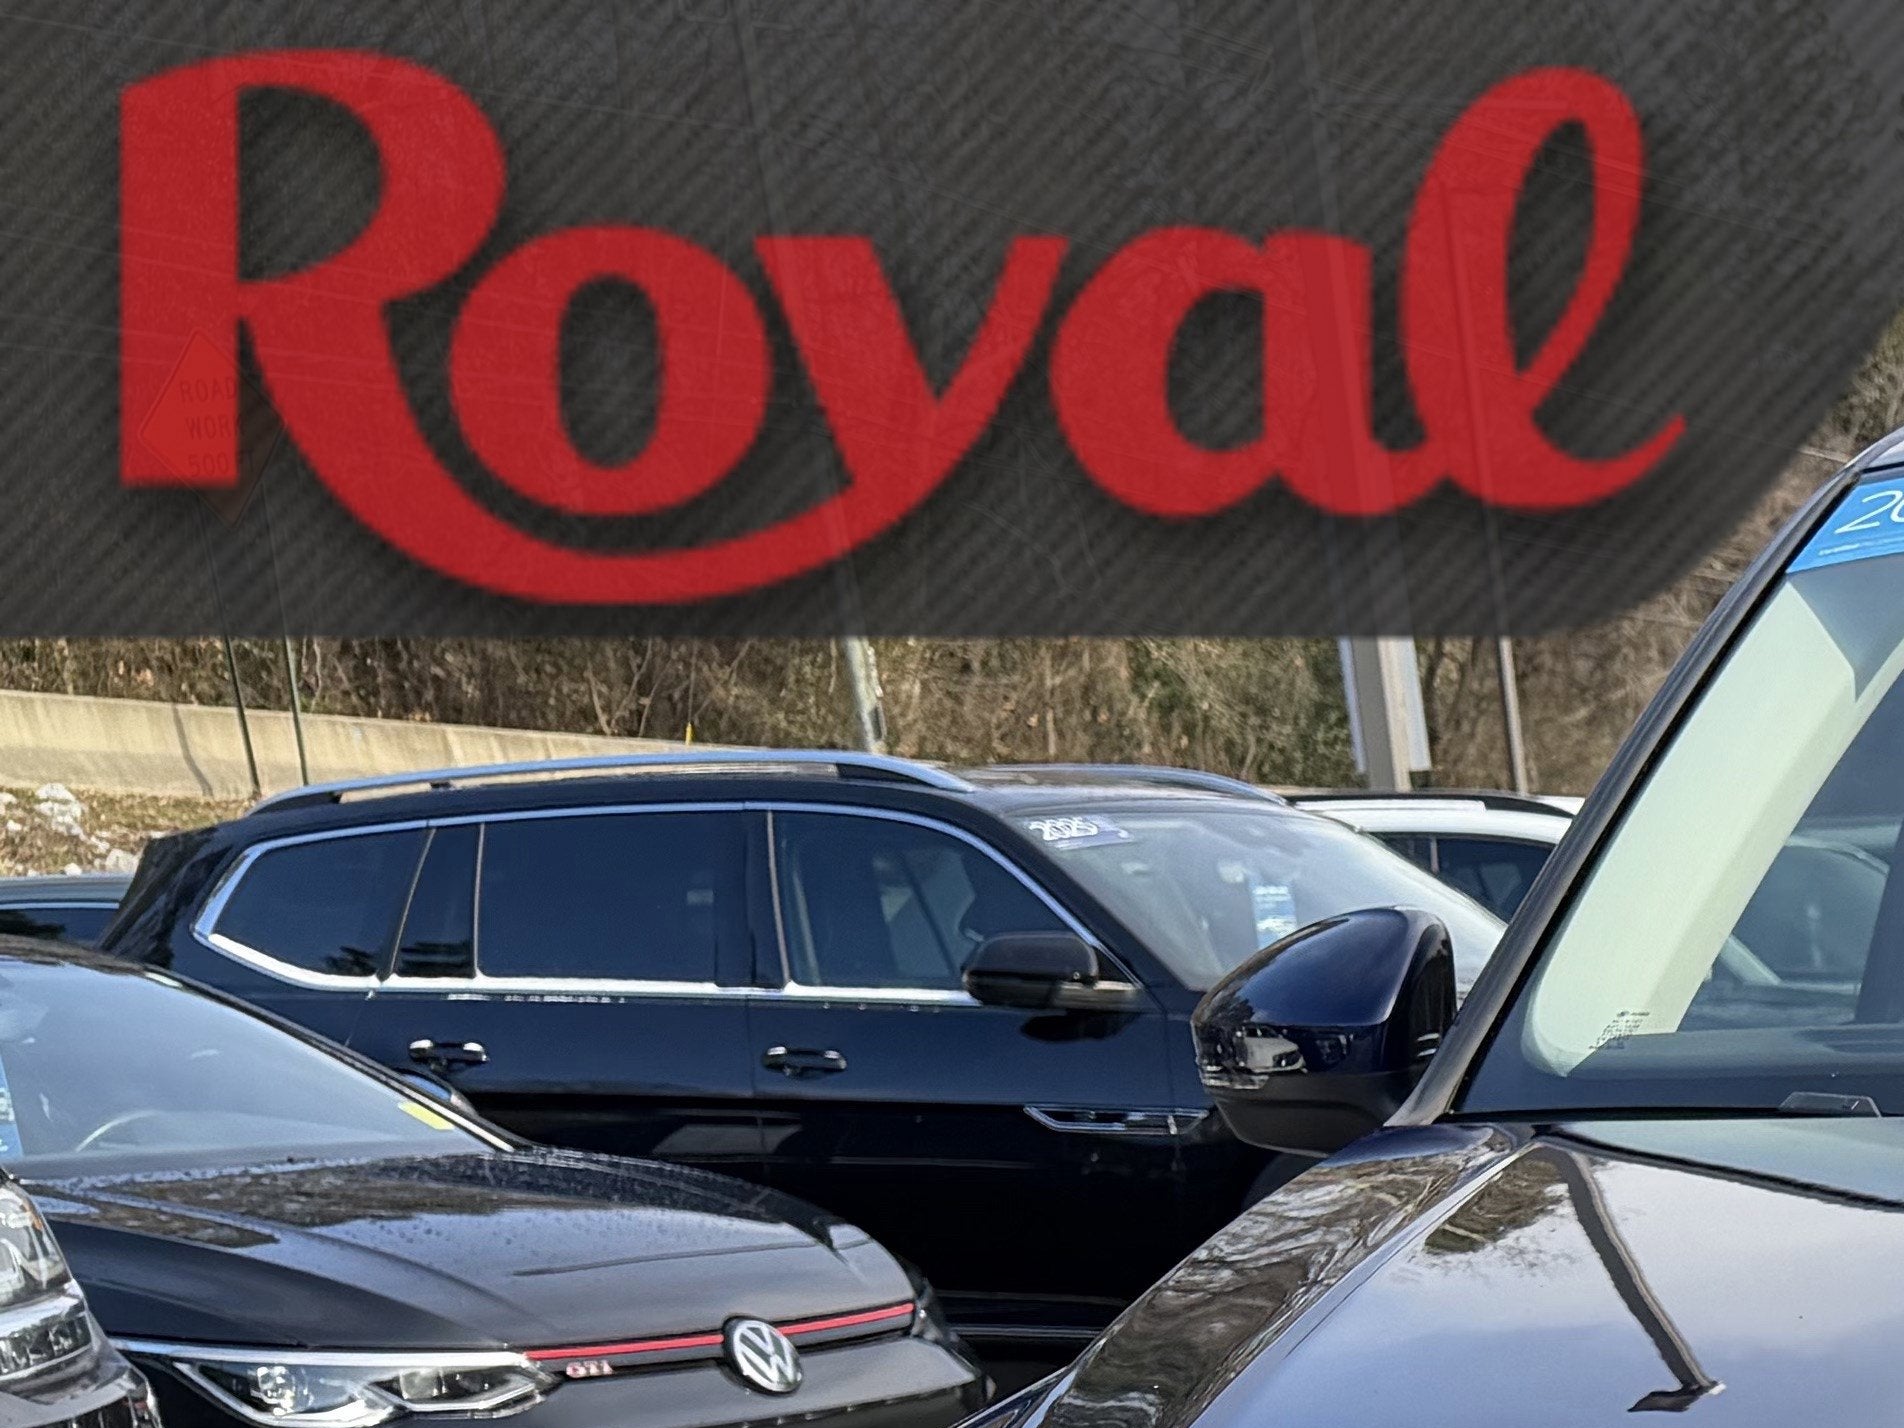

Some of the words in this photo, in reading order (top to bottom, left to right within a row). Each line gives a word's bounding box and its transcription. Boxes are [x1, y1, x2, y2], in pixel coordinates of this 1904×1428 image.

[178, 376, 238, 405] ROAD
[185, 413, 246, 441] WORK
[187, 451, 230, 479] 500
[565, 1359, 614, 1379] GTI
